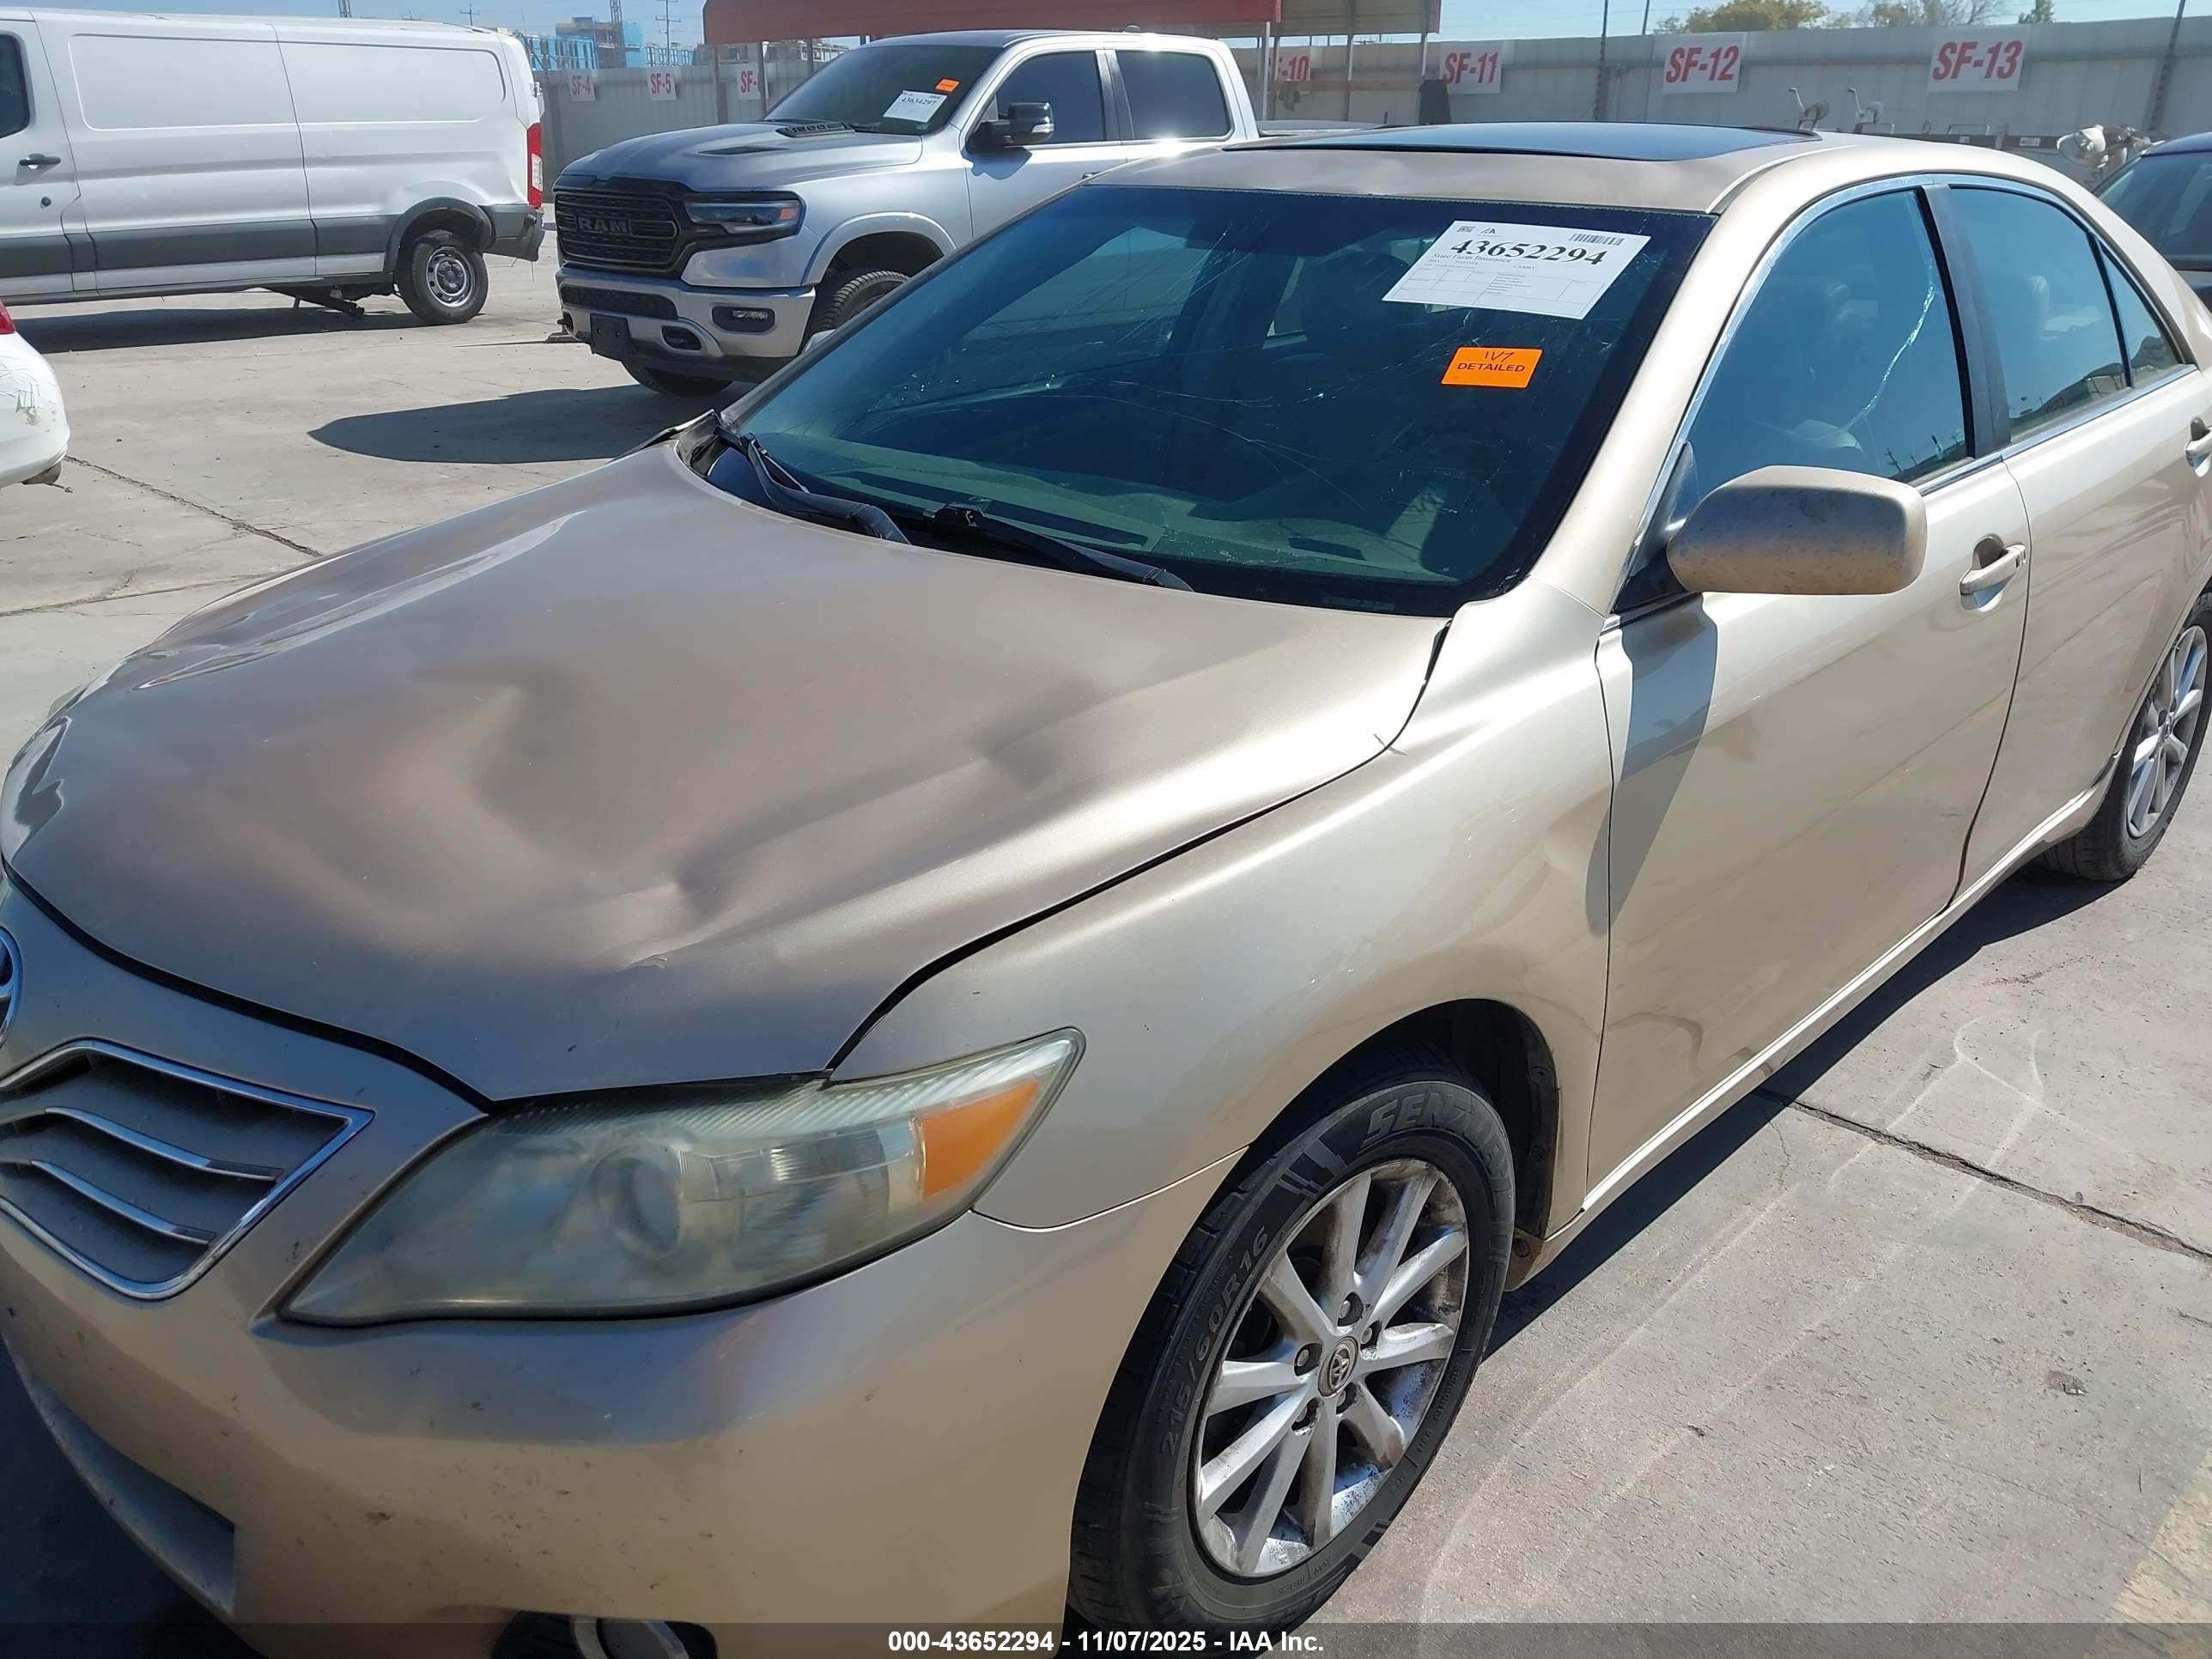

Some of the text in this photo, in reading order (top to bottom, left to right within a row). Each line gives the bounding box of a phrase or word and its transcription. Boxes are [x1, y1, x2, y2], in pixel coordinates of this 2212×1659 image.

[1443, 52, 1500, 84] SF-11
[1665, 46, 1740, 83] SF-12
[1932, 40, 2024, 81] SF-13
[571, 75, 592, 95] SF-4
[650, 73, 672, 94] SF-5
[577, 216, 629, 234] RAM
[1450, 239, 1608, 265] 43652294
[1475, 255, 1512, 264] Insurance
[1456, 362, 1526, 372] DETAILED
